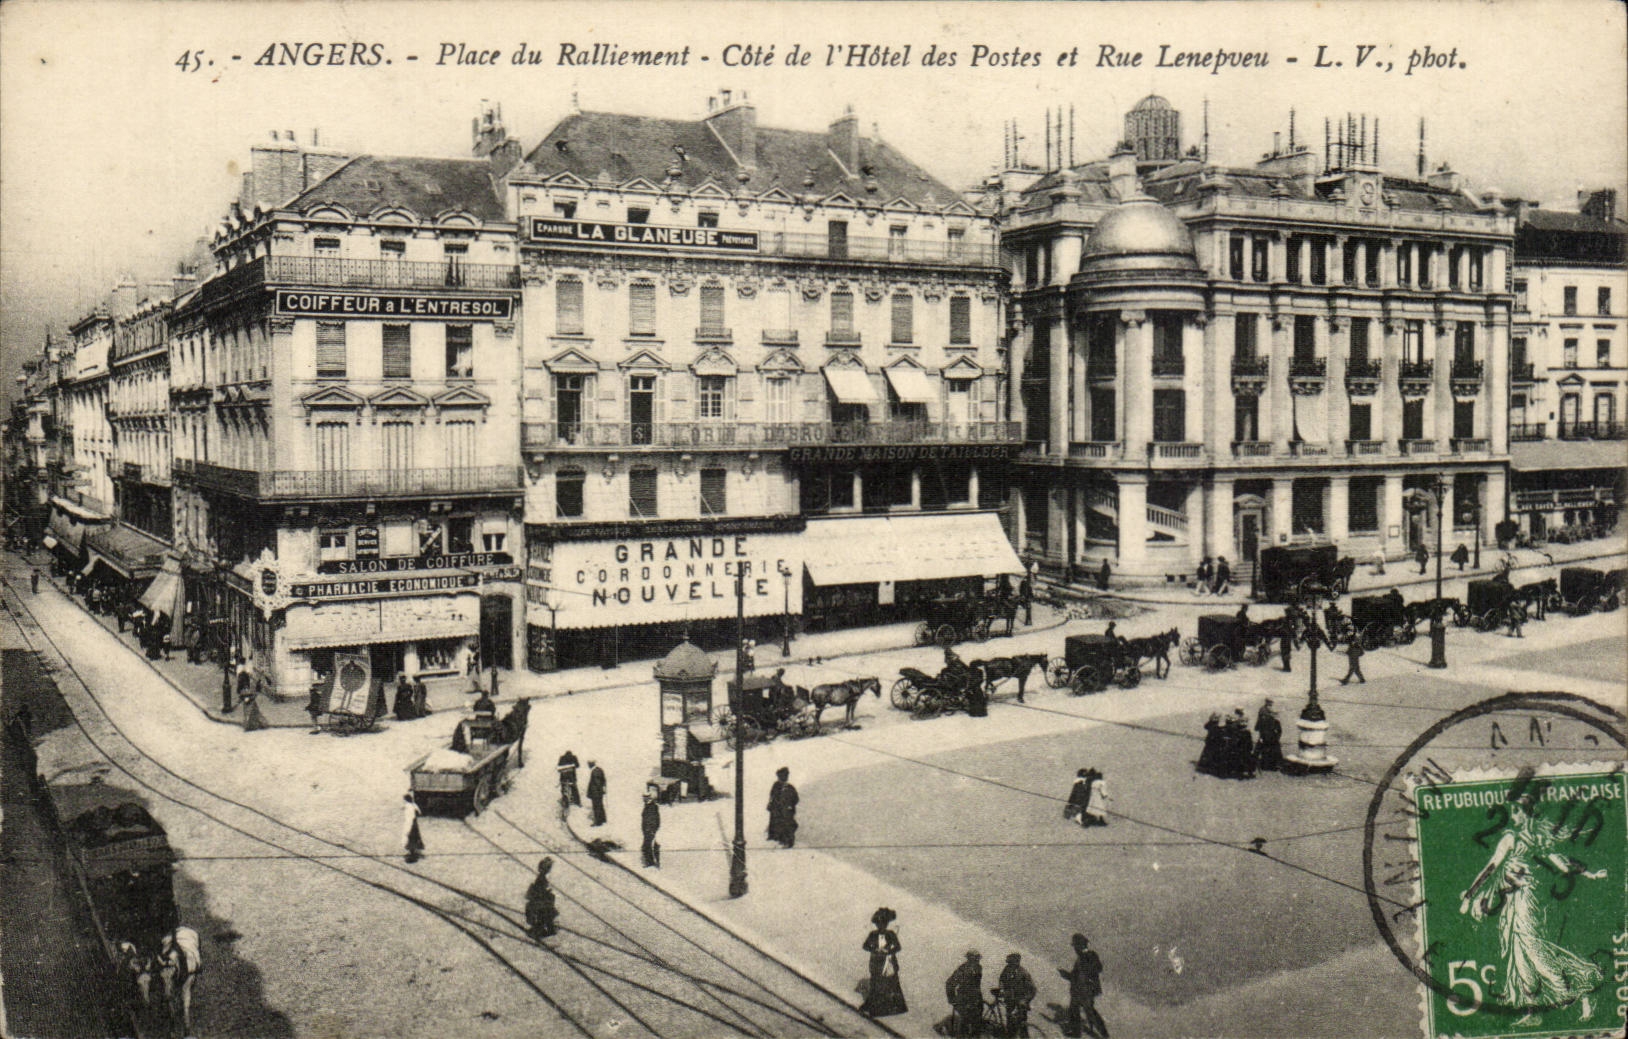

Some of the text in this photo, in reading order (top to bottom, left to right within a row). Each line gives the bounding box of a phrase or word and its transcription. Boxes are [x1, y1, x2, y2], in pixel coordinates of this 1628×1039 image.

[577, 222, 605, 240] LA
[614, 226, 718, 246] GLANEUSE
[286, 294, 380, 313] COIFFEUR
[400, 297, 502, 315] L'ENTRESOL
[614, 536, 748, 564] GRANDE
[339, 553, 495, 574] SALON DE COIFFURE
[575, 558, 786, 585] CORDONNERIE
[308, 576, 464, 596] PHARMACIE ECONOMIQUE
[592, 579, 769, 606] NOUVELLE
